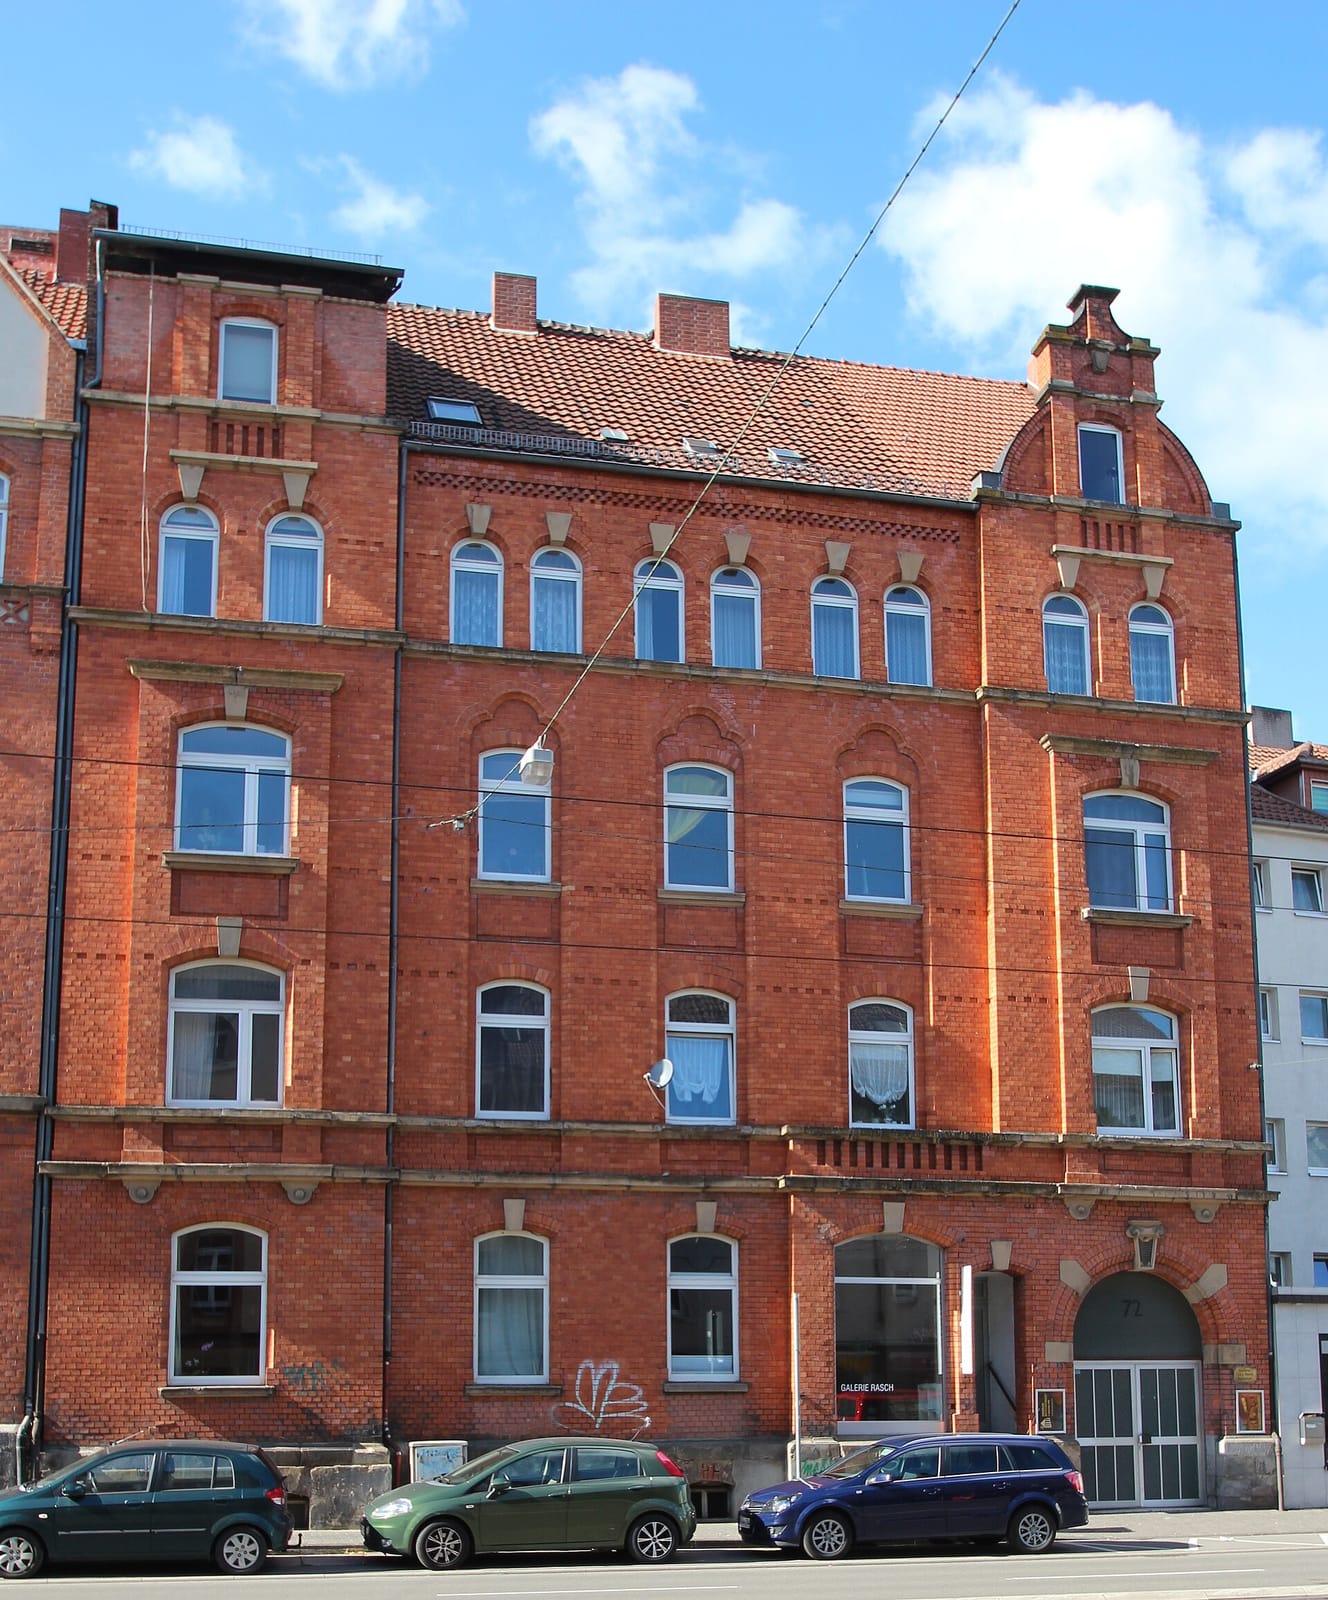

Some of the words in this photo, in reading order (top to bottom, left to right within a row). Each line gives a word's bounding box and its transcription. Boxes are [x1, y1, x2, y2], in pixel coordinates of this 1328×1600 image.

[1121, 1299, 1144, 1318] 72
[840, 1383, 869, 1392] GALERIE
[870, 1383, 894, 1392] RASCH
